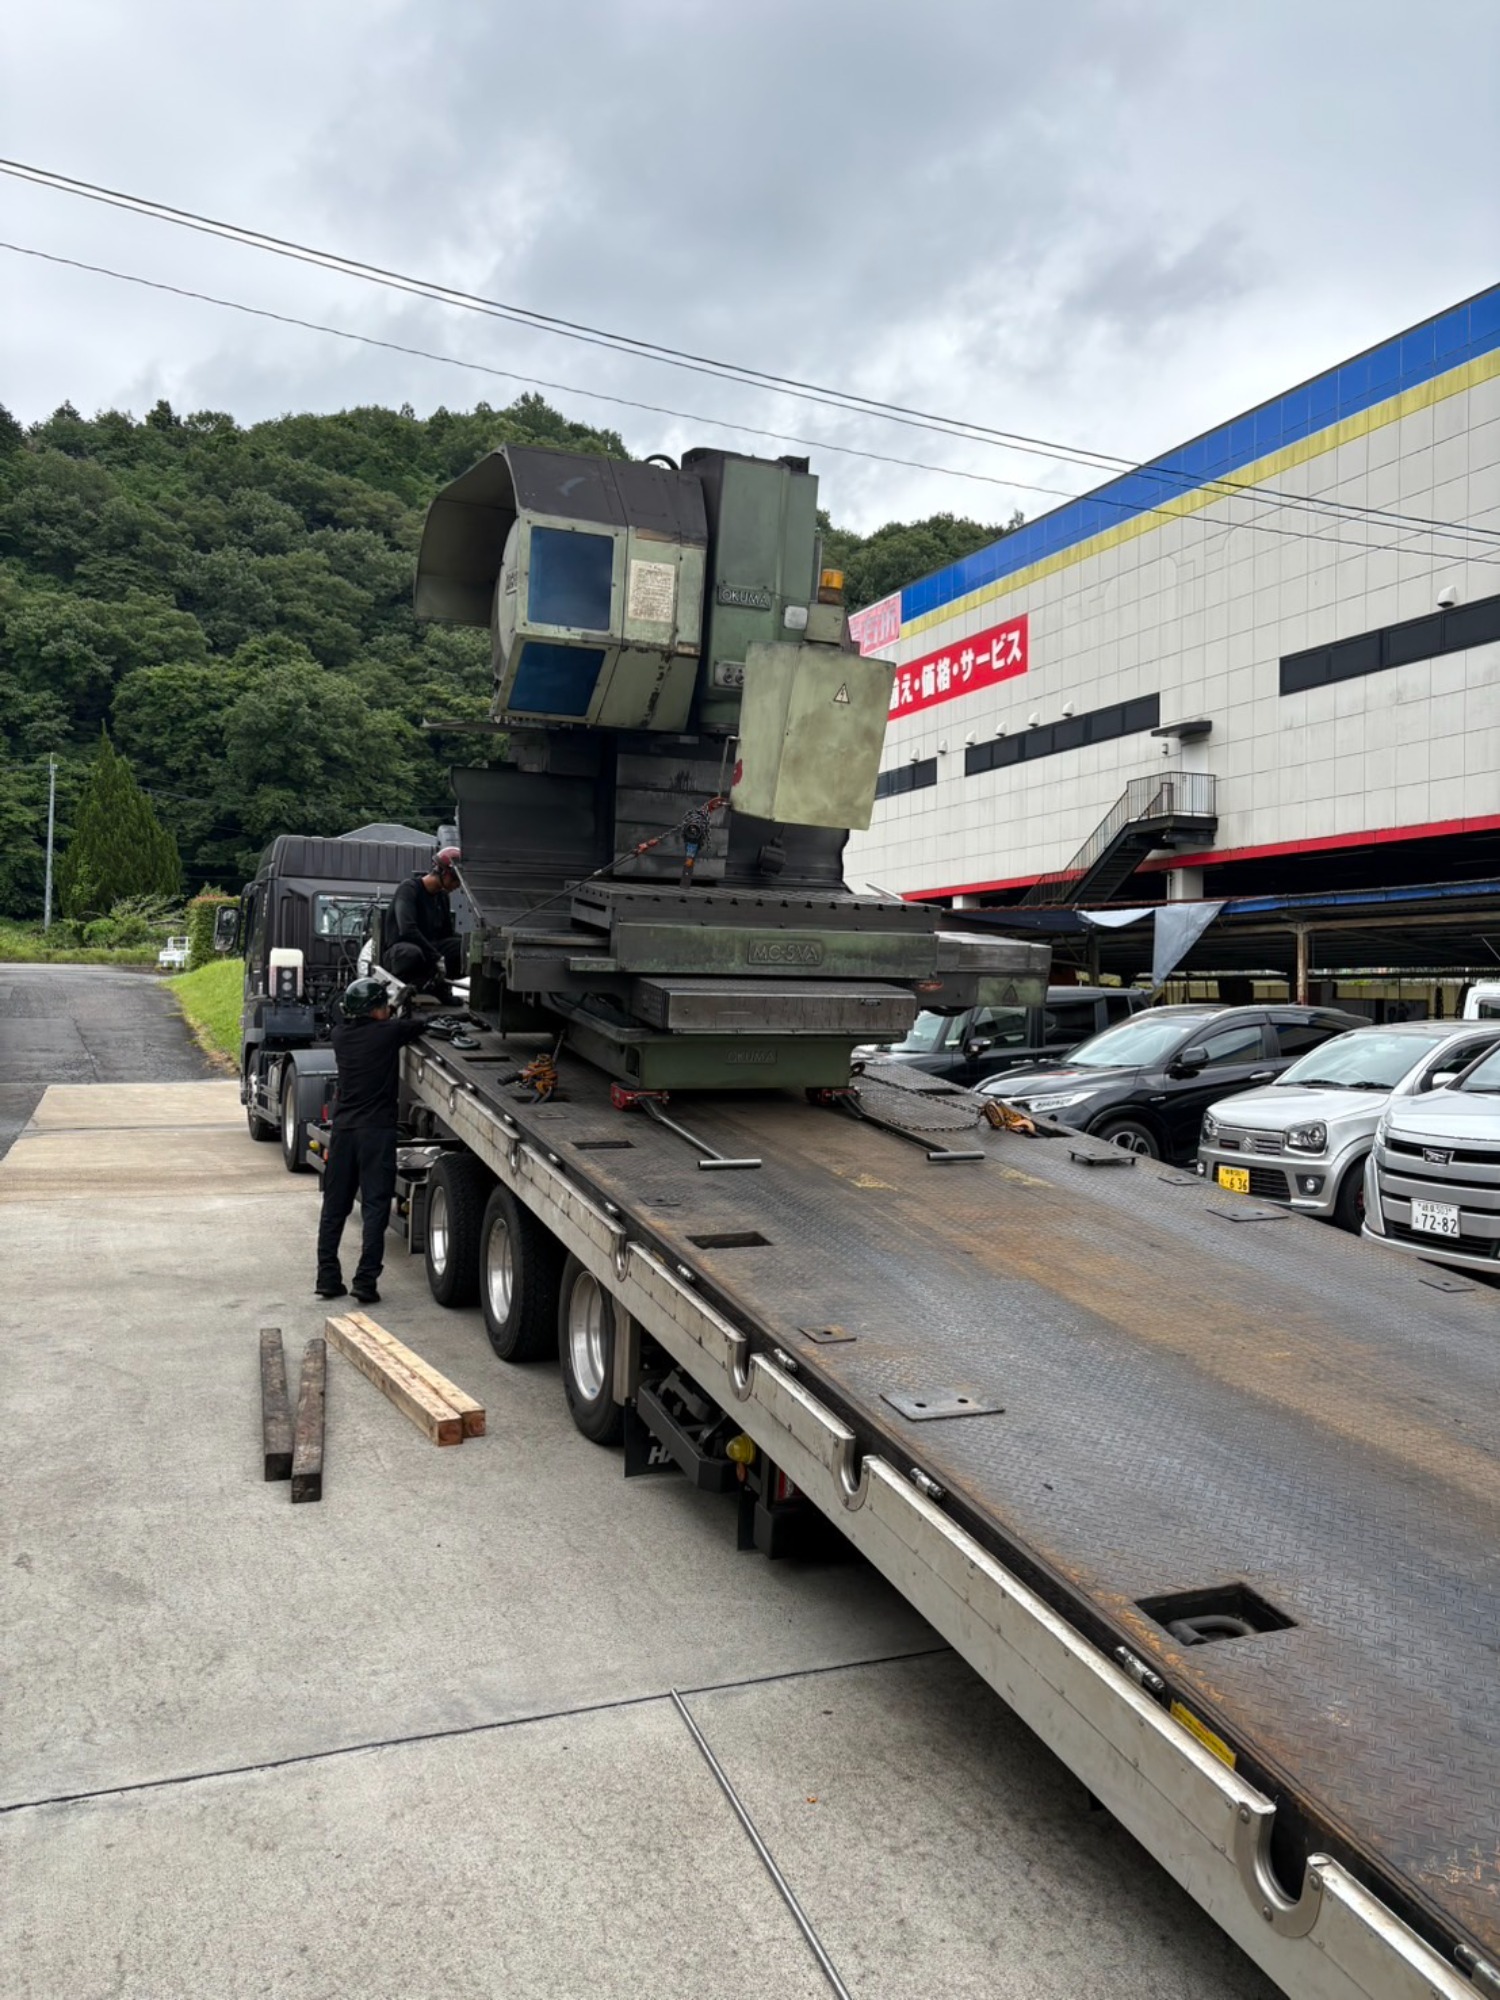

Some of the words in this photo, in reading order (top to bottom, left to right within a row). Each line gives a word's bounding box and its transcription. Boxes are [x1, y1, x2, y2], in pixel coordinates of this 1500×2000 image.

[722, 588, 768, 606] OKUMA
[727, 1048, 776, 1063] OKUMA
[1421, 1212, 1457, 1235] 72-82
